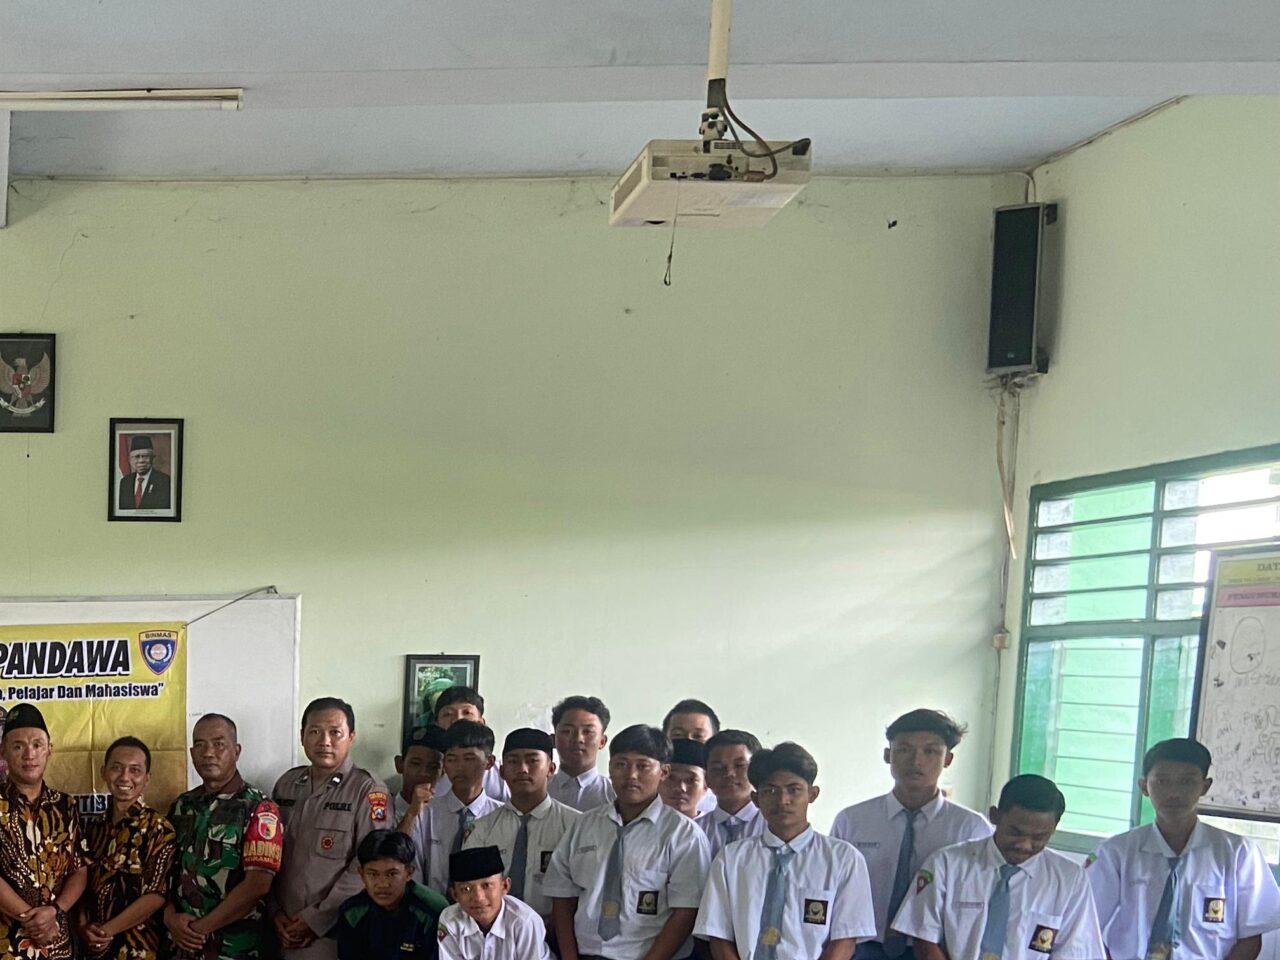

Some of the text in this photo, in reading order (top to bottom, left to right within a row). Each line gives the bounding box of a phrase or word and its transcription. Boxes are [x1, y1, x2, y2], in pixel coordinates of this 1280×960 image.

[8, 686, 55, 700] Pelajar
[58, 685, 82, 698] Dan
[85, 682, 164, 698] Mahasiswa"
